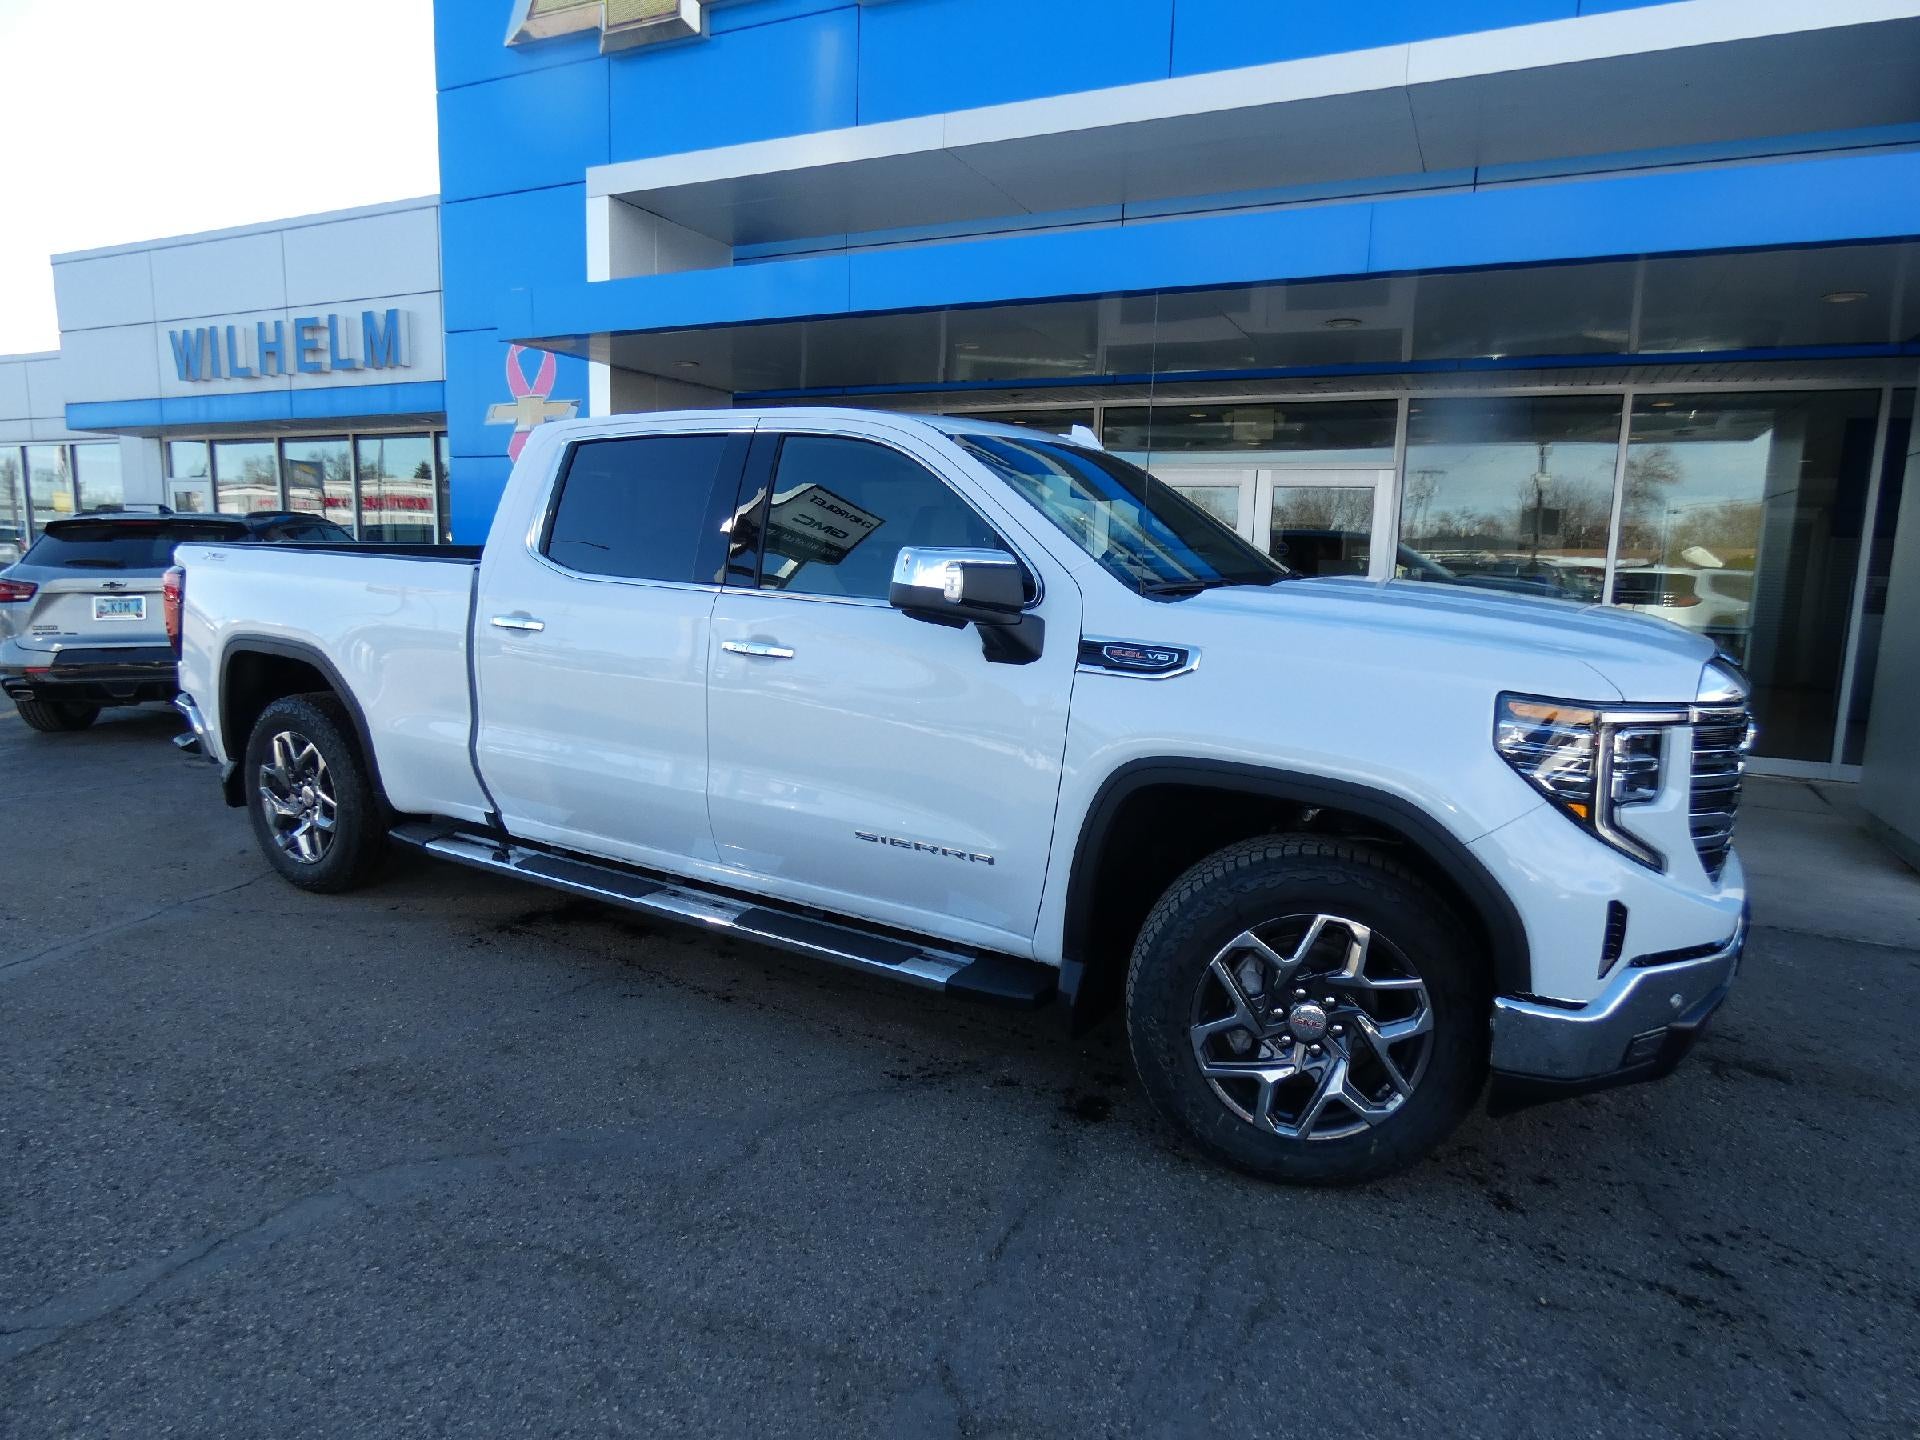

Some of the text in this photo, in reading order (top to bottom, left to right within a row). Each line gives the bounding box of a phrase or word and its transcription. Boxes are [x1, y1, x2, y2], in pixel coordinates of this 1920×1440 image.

[168, 308, 406, 382] WILHELM
[1146, 652, 1170, 662] V8
[854, 829, 995, 866] SIERRA
